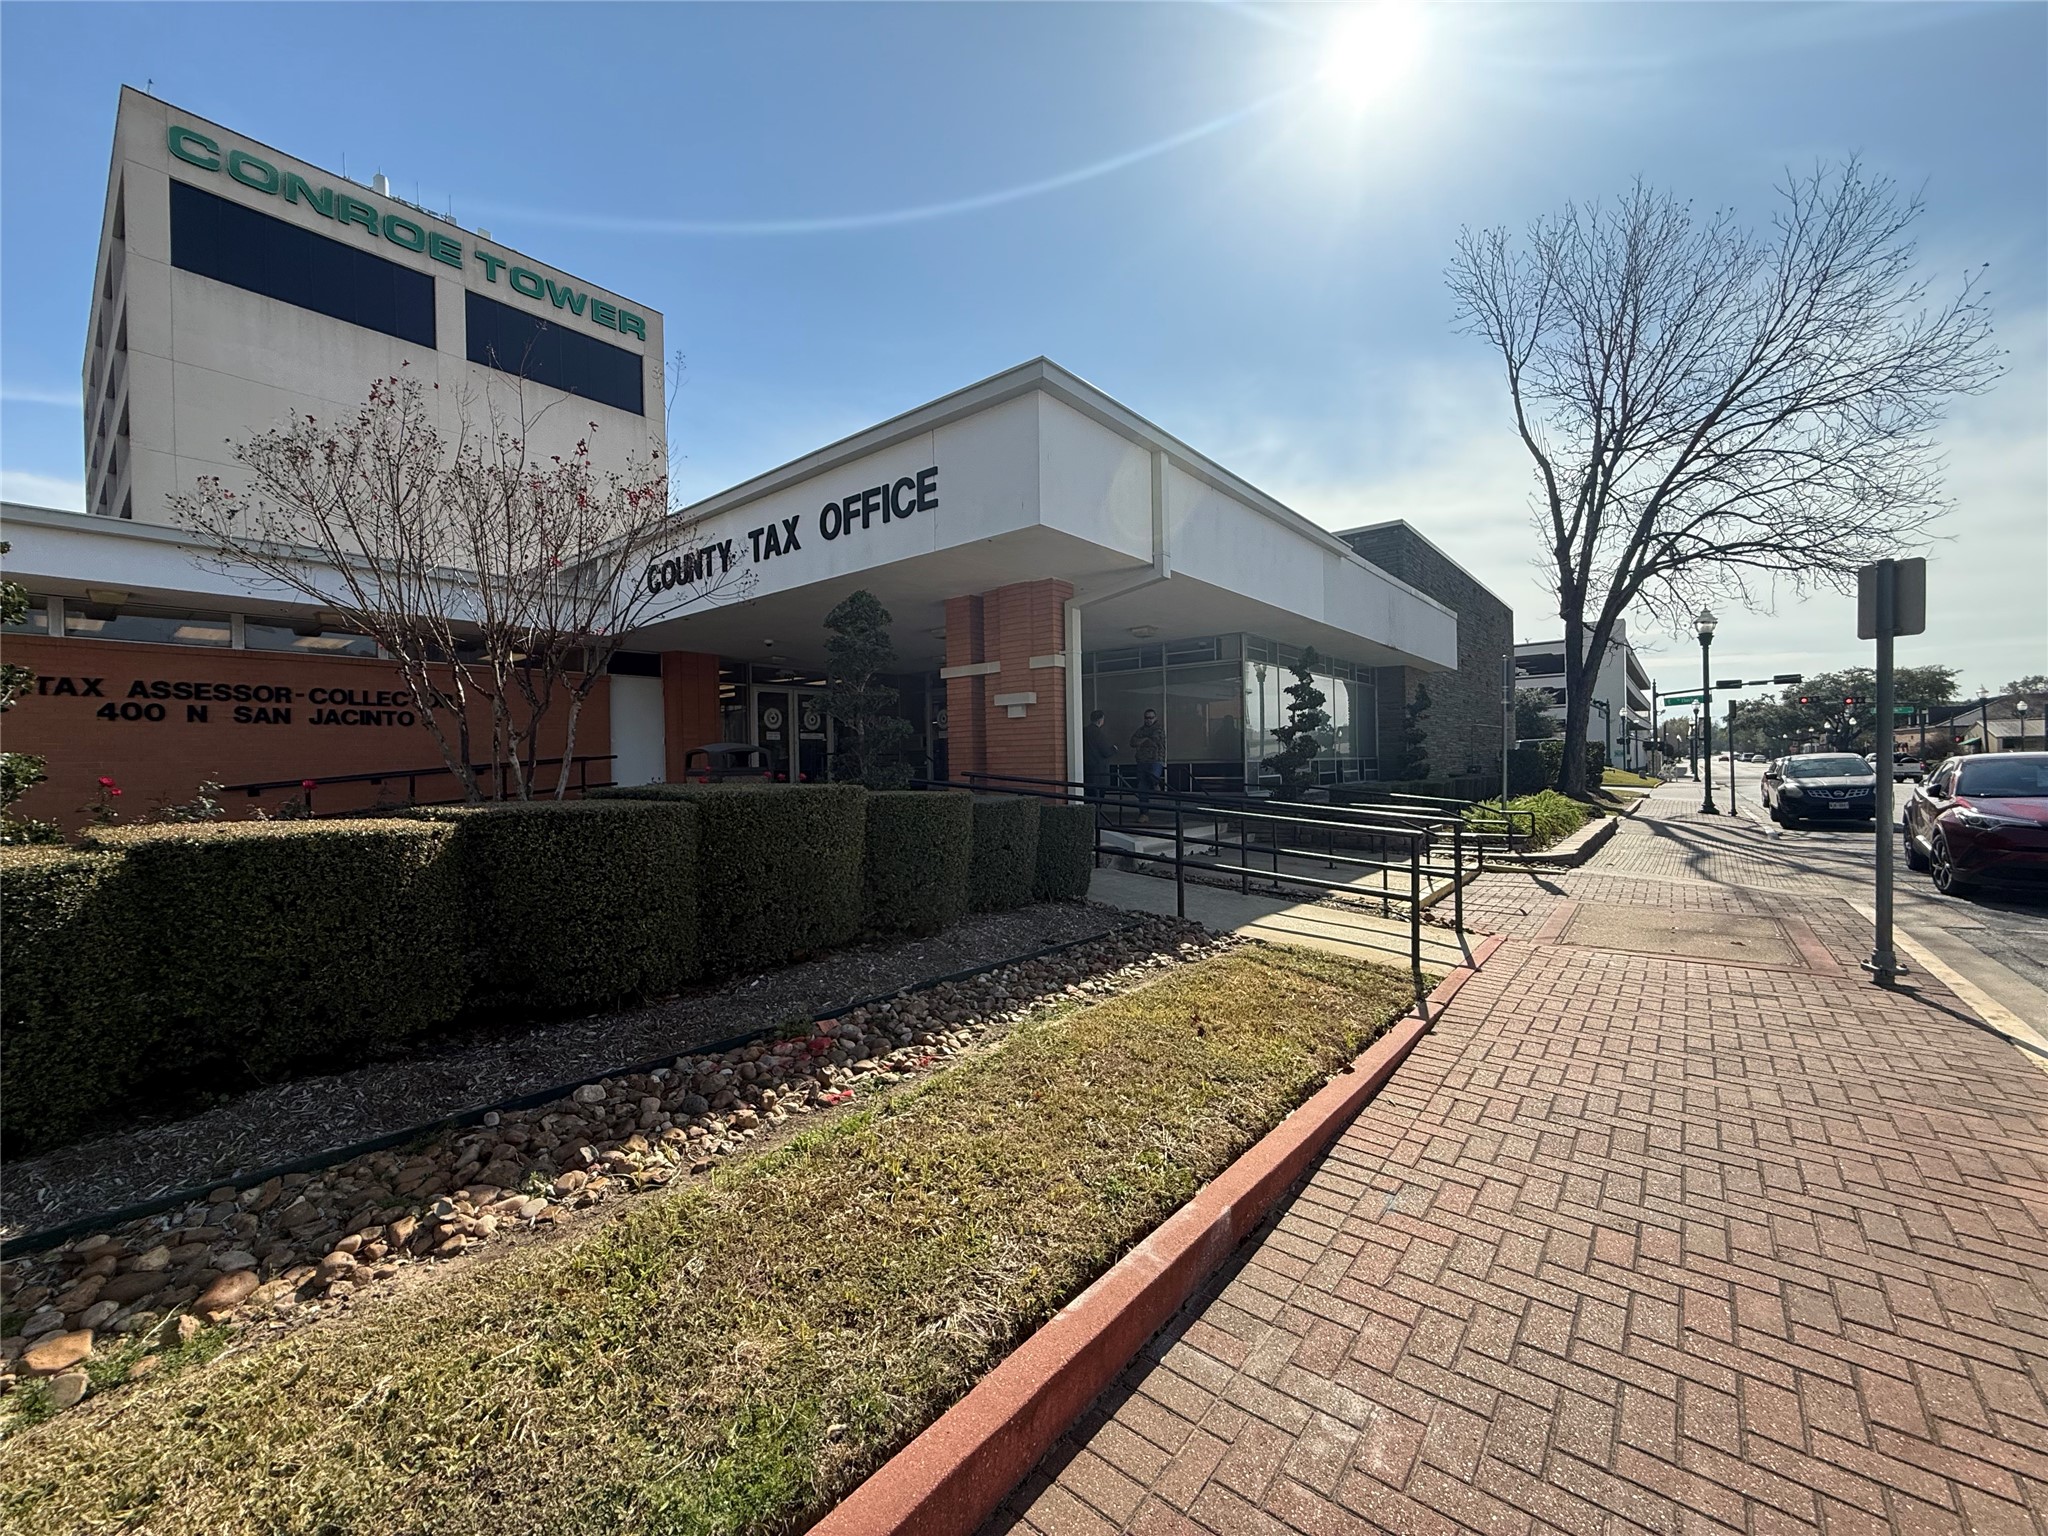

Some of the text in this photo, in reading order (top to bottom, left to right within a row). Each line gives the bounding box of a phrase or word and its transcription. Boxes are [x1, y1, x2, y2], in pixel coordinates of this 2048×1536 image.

[167, 125, 647, 342] CONROE TOWER
[647, 466, 939, 593] COUNTY TAX OFFICE
[37, 676, 453, 709] TAX ASSESSOR-COLLECO
[96, 702, 415, 727] 400 N SAN JACINTO
